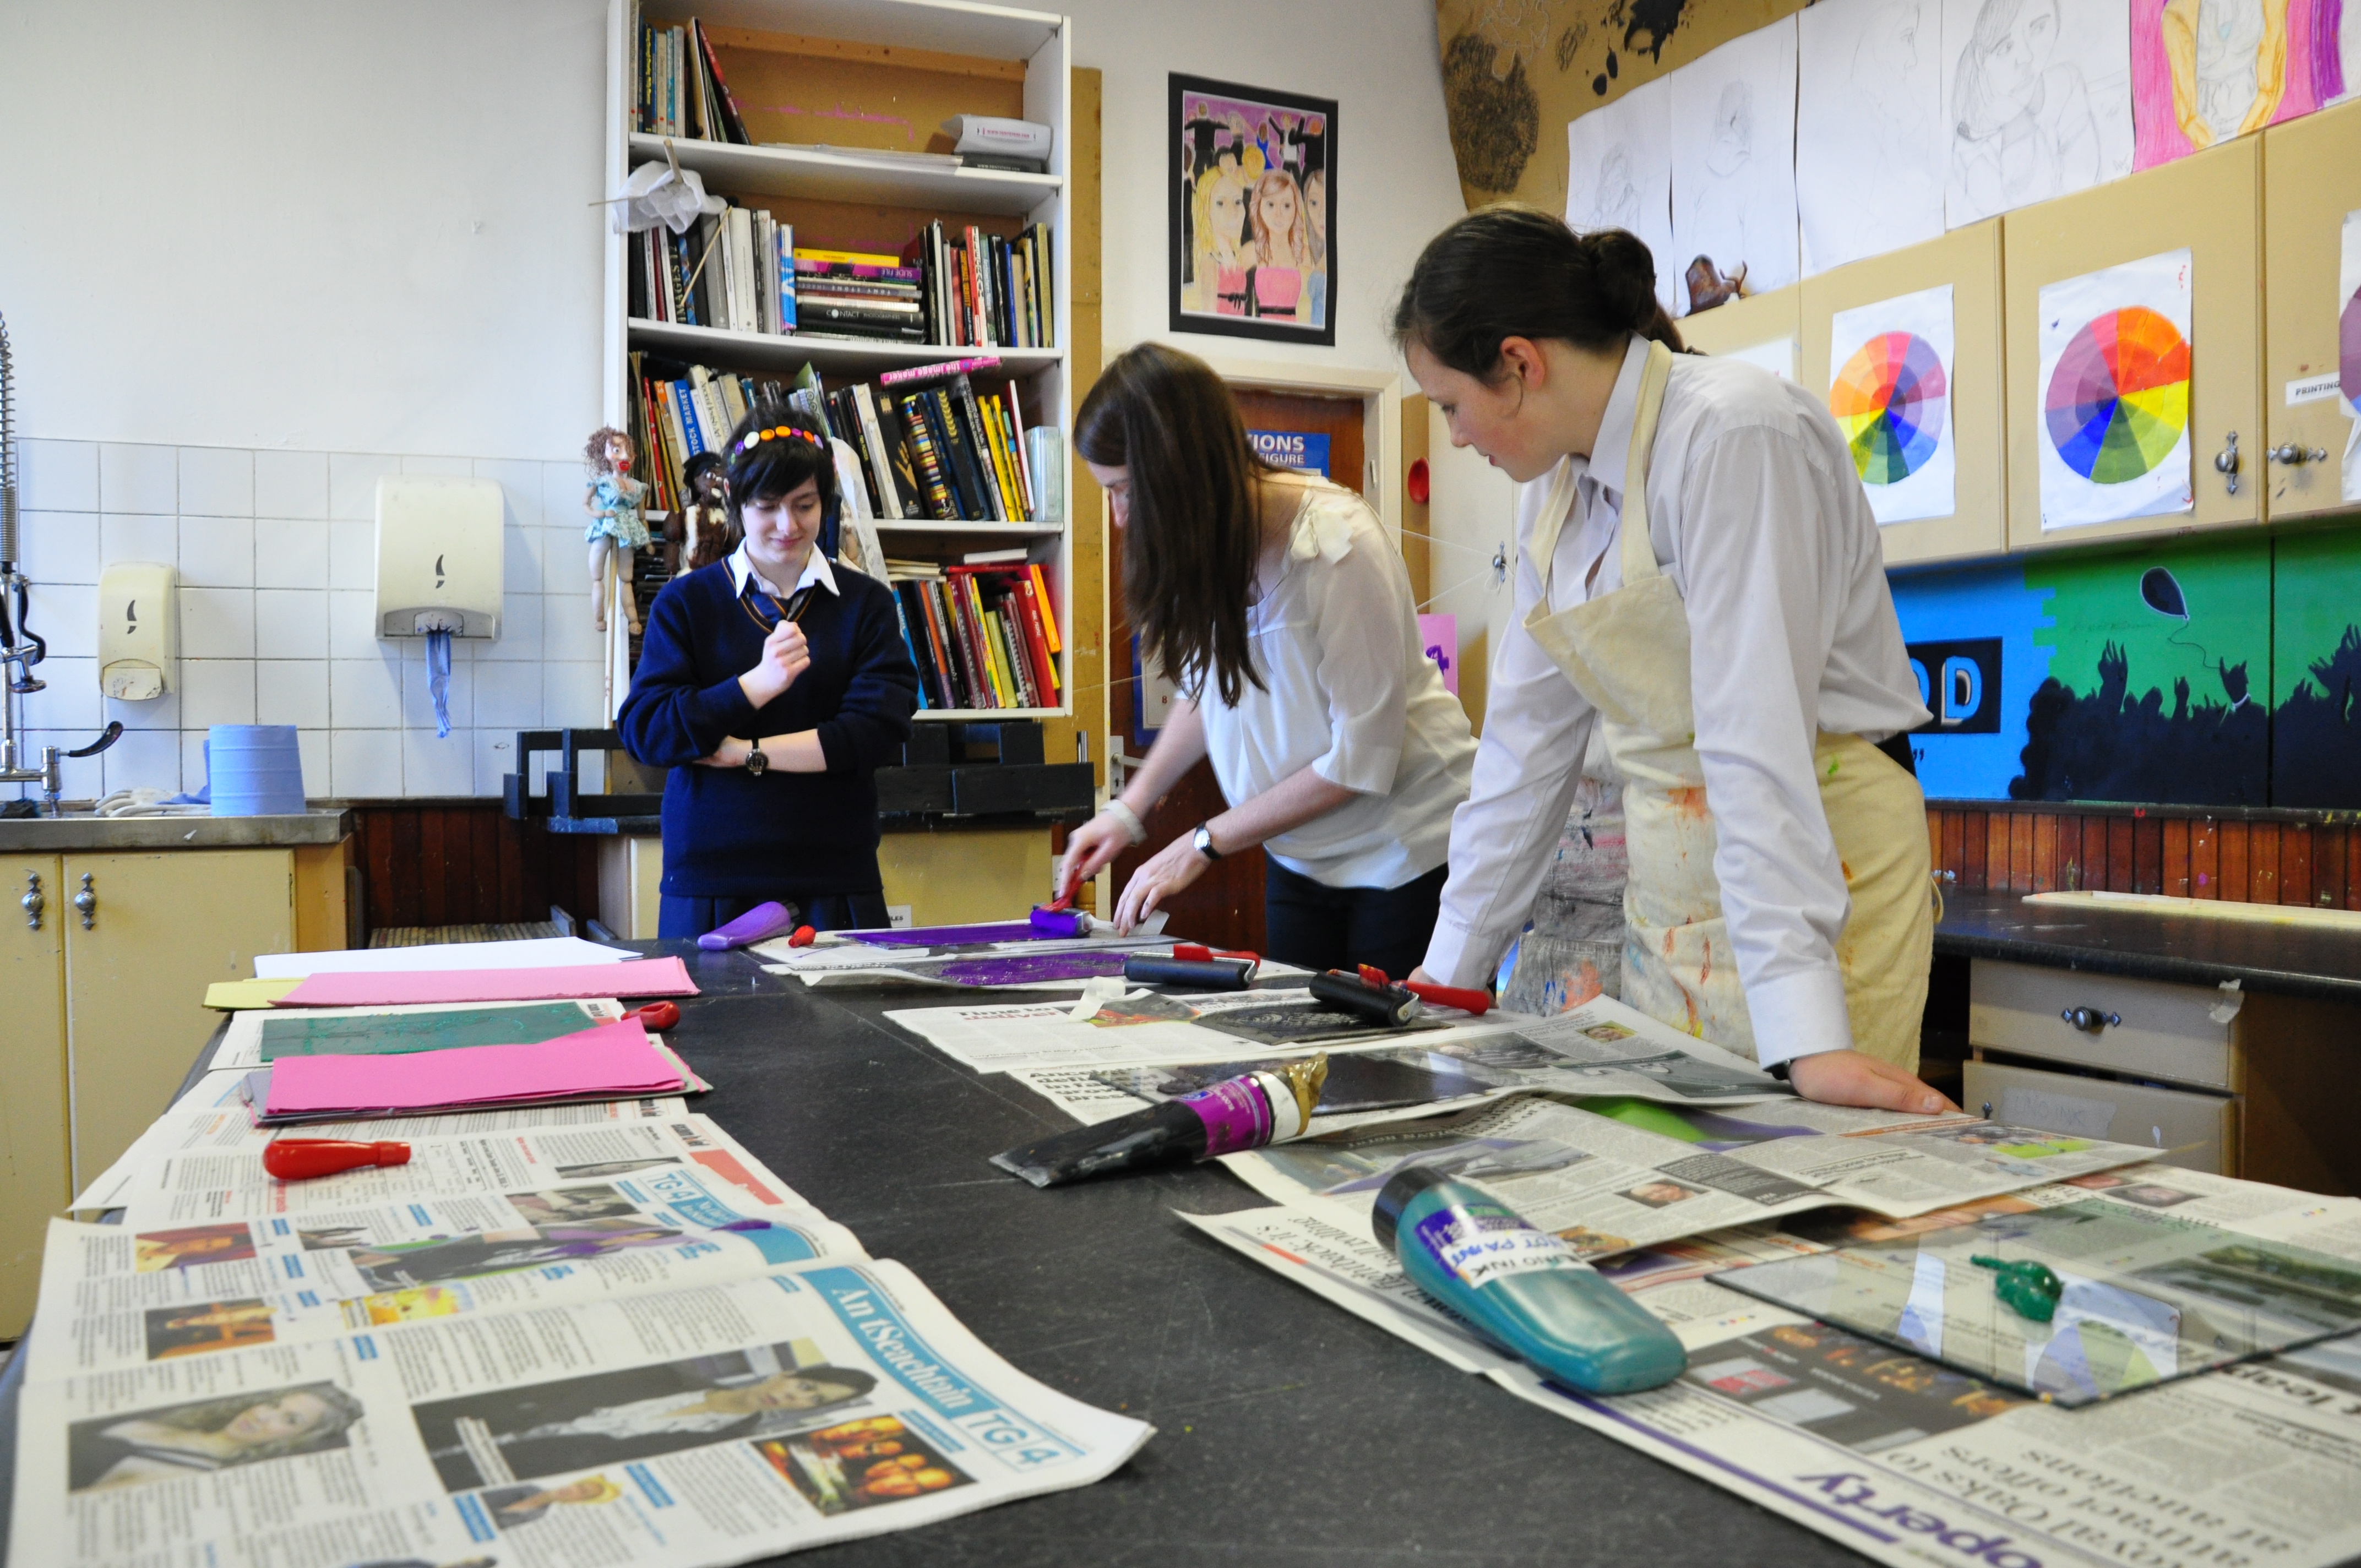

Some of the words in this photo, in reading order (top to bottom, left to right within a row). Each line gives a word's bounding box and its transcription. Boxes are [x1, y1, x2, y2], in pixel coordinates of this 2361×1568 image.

[882, 266, 894, 275] FILE
[895, 268, 913, 277] SLIDE
[671, 265, 687, 323] IMAGES
[889, 367, 916, 380] maker
[918, 364, 942, 375] image
[945, 362, 960, 371] the
[2295, 380, 2340, 396] PRINTING
[678, 388, 694, 424] MARKET
[688, 427, 701, 456] STOCK
[1259, 453, 1305, 464] FIGURE
[963, 1011, 1059, 1020] deliver
[1470, 1257, 1515, 1278] INK
[831, 1287, 869, 1321] An
[858, 1317, 973, 1413] tSeachtain
[1887, 1450, 1930, 1473] to
[1941, 1444, 2069, 1497] offers
[1937, 1469, 2049, 1523] Oaks
[2021, 1447, 2224, 1529] auctions
[2075, 1494, 2253, 1568] attract
[2232, 1522, 2292, 1556] at
